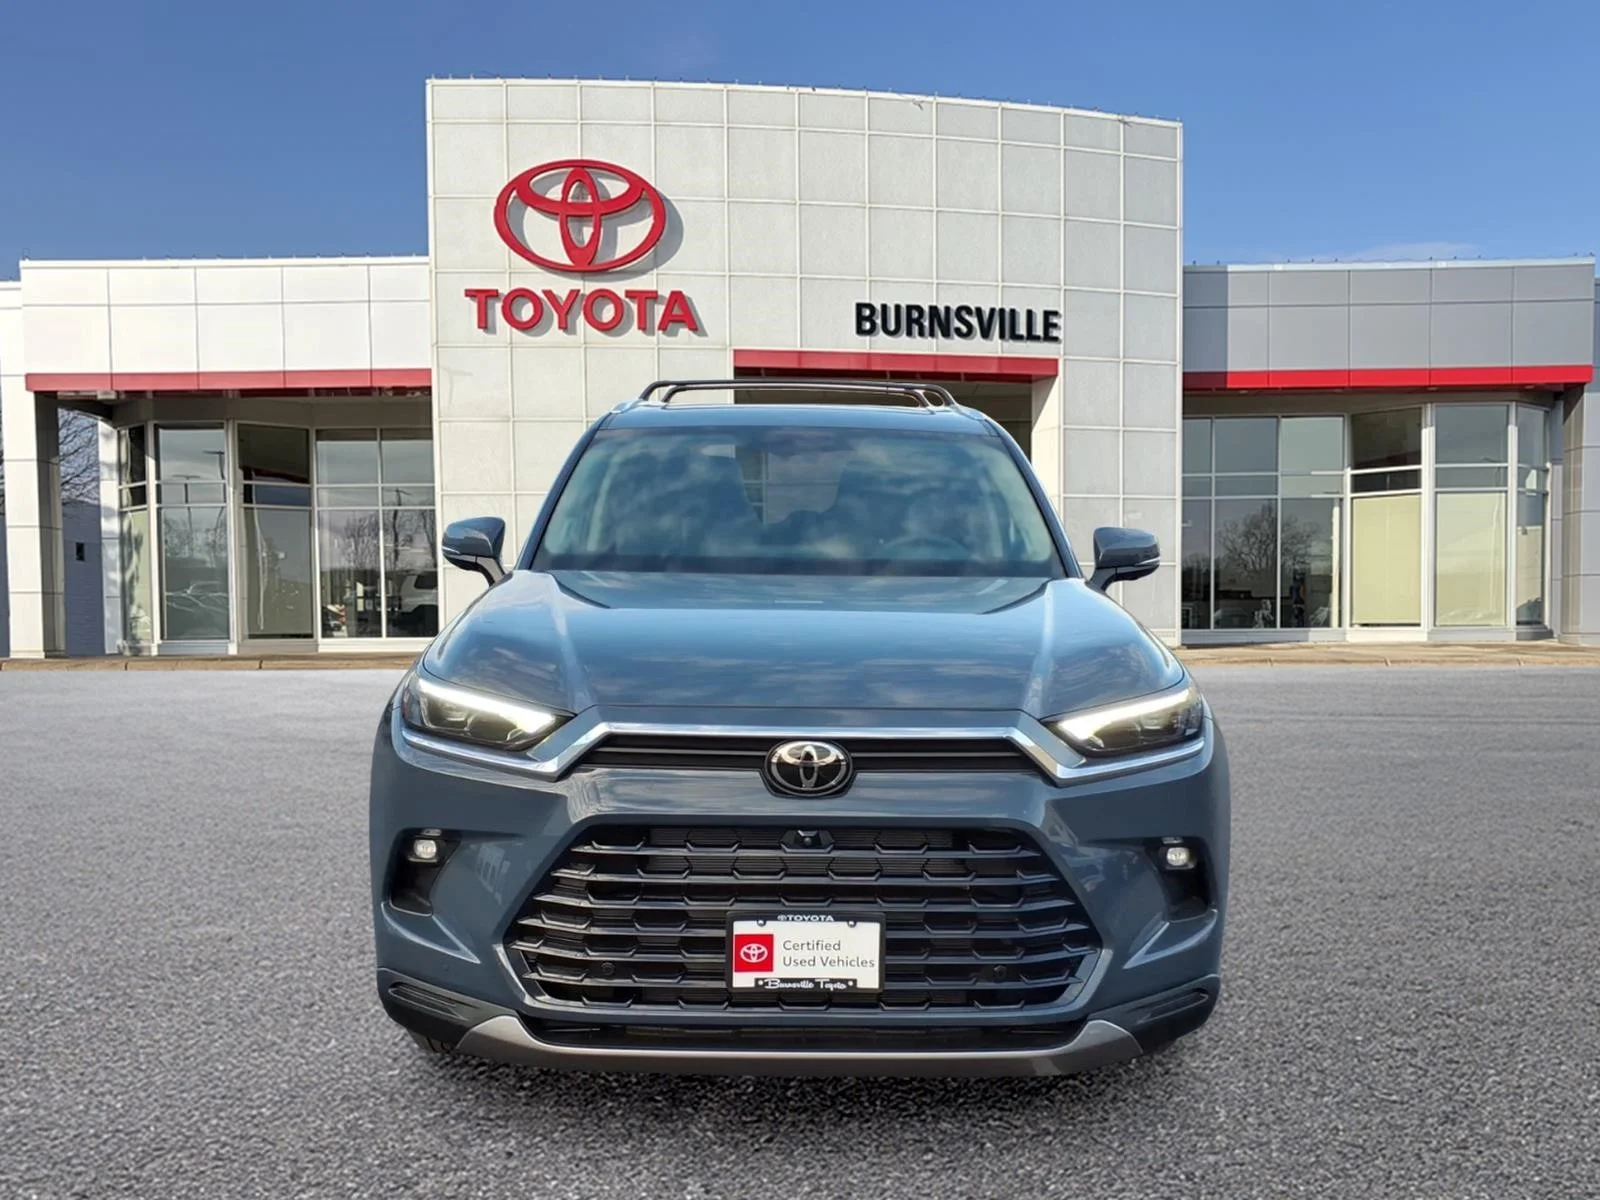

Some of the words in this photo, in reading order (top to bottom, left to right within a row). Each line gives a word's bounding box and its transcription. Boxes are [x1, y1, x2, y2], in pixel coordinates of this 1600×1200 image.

[465, 287, 699, 332] TOYOTA
[855, 302, 1061, 342] BURNSVILLE
[787, 914, 834, 922] TOYOTA
[783, 940, 841, 951] Certified
[783, 957, 815, 967] Used
[820, 957, 875, 967] Vehicles
